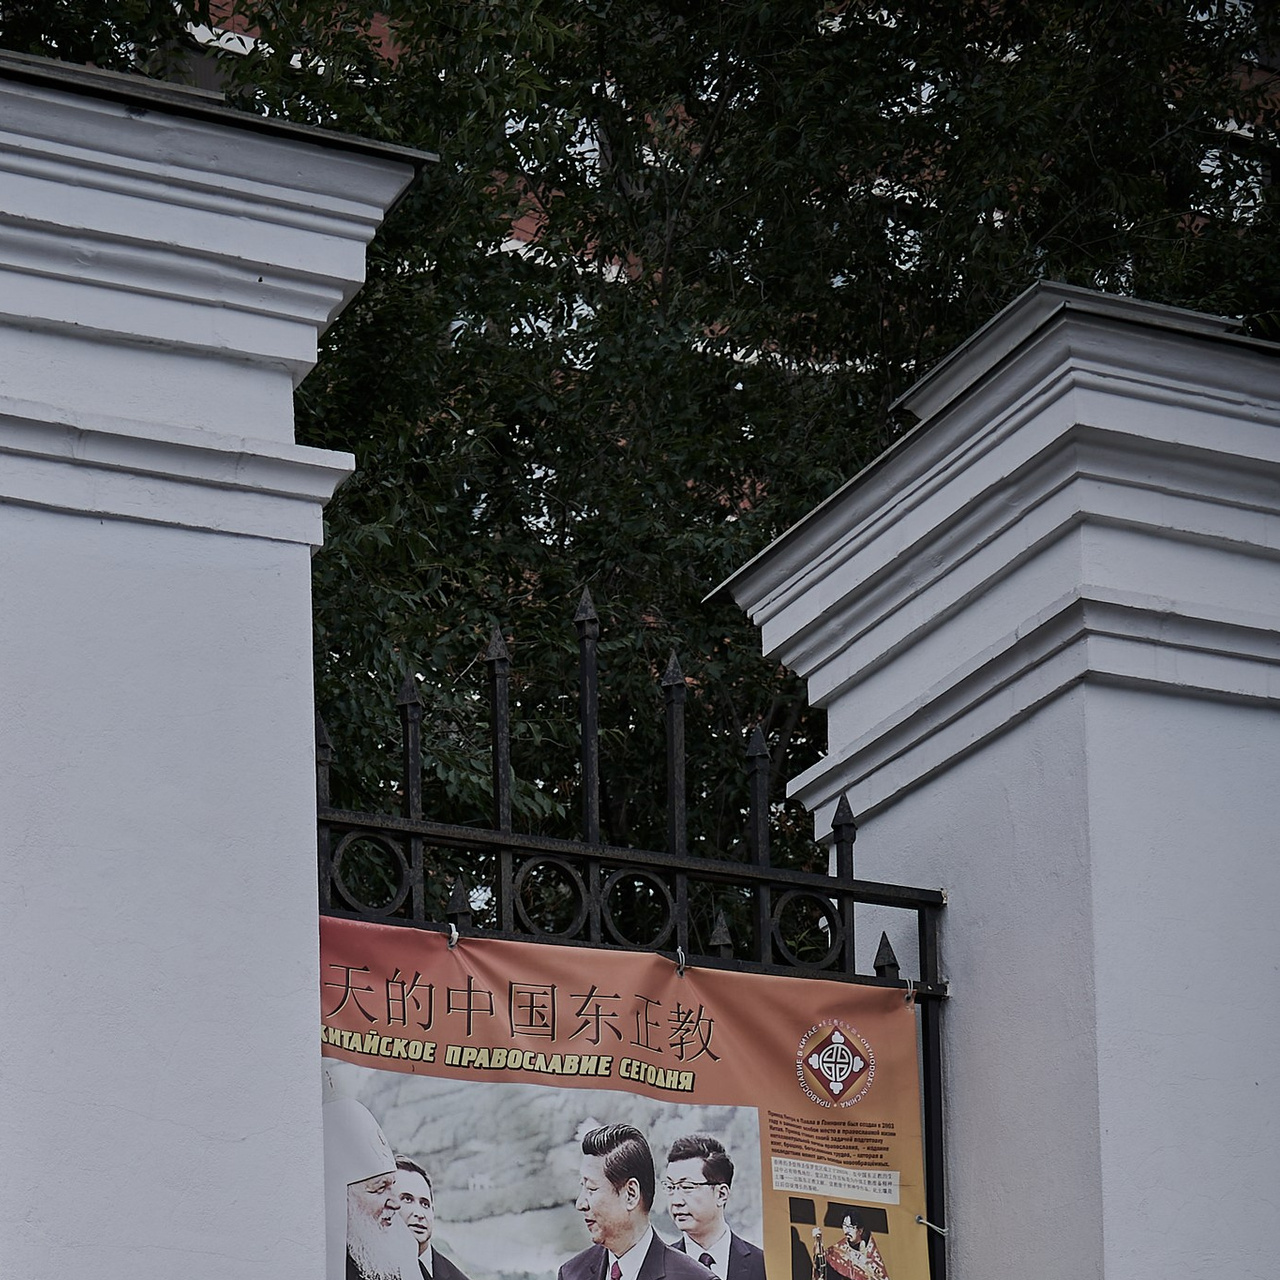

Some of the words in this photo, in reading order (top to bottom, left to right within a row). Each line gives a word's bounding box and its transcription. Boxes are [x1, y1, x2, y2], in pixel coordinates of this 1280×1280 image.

[324, 963, 720, 1062] 天的中国东正教
[321, 1024, 436, 1062] КИТАЙСКОЕ
[445, 1045, 612, 1078] ПРАВОСЛАВИЕ
[619, 1058, 694, 1092] СЕГОДНЯ
[798, 1026, 818, 1049] КИТАЕ
[796, 1060, 831, 1108] ПРАВОСЛАВИЕ
[861, 1038, 876, 1087] ORTHODOXY
[840, 1094, 862, 1108] CHINA
